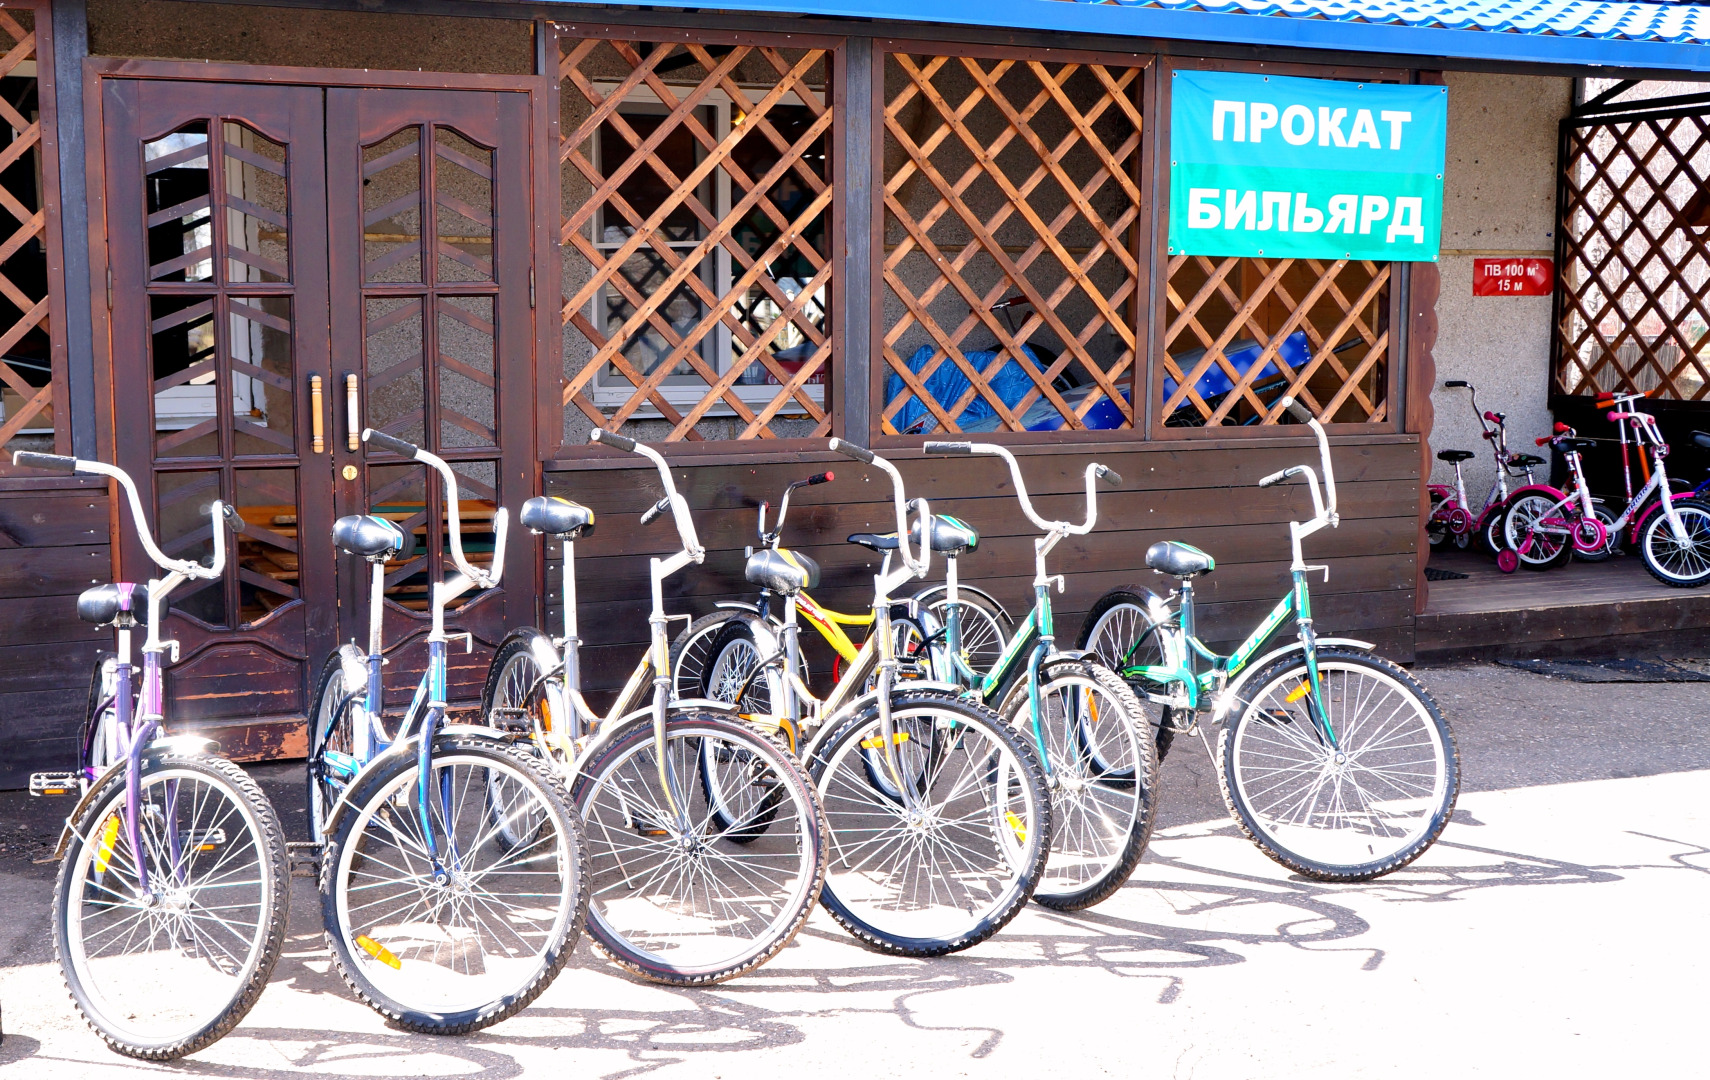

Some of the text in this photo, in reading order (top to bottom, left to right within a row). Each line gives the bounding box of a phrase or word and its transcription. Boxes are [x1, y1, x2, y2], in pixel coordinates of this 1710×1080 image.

[1212, 100, 1412, 150] ПРОКАТ
[1187, 188, 1424, 244] БИЛЬЯРД
[1484, 264, 1502, 276] ПВ
[1505, 264, 1524, 276] 100
[1498, 279, 1523, 291] 15 м
